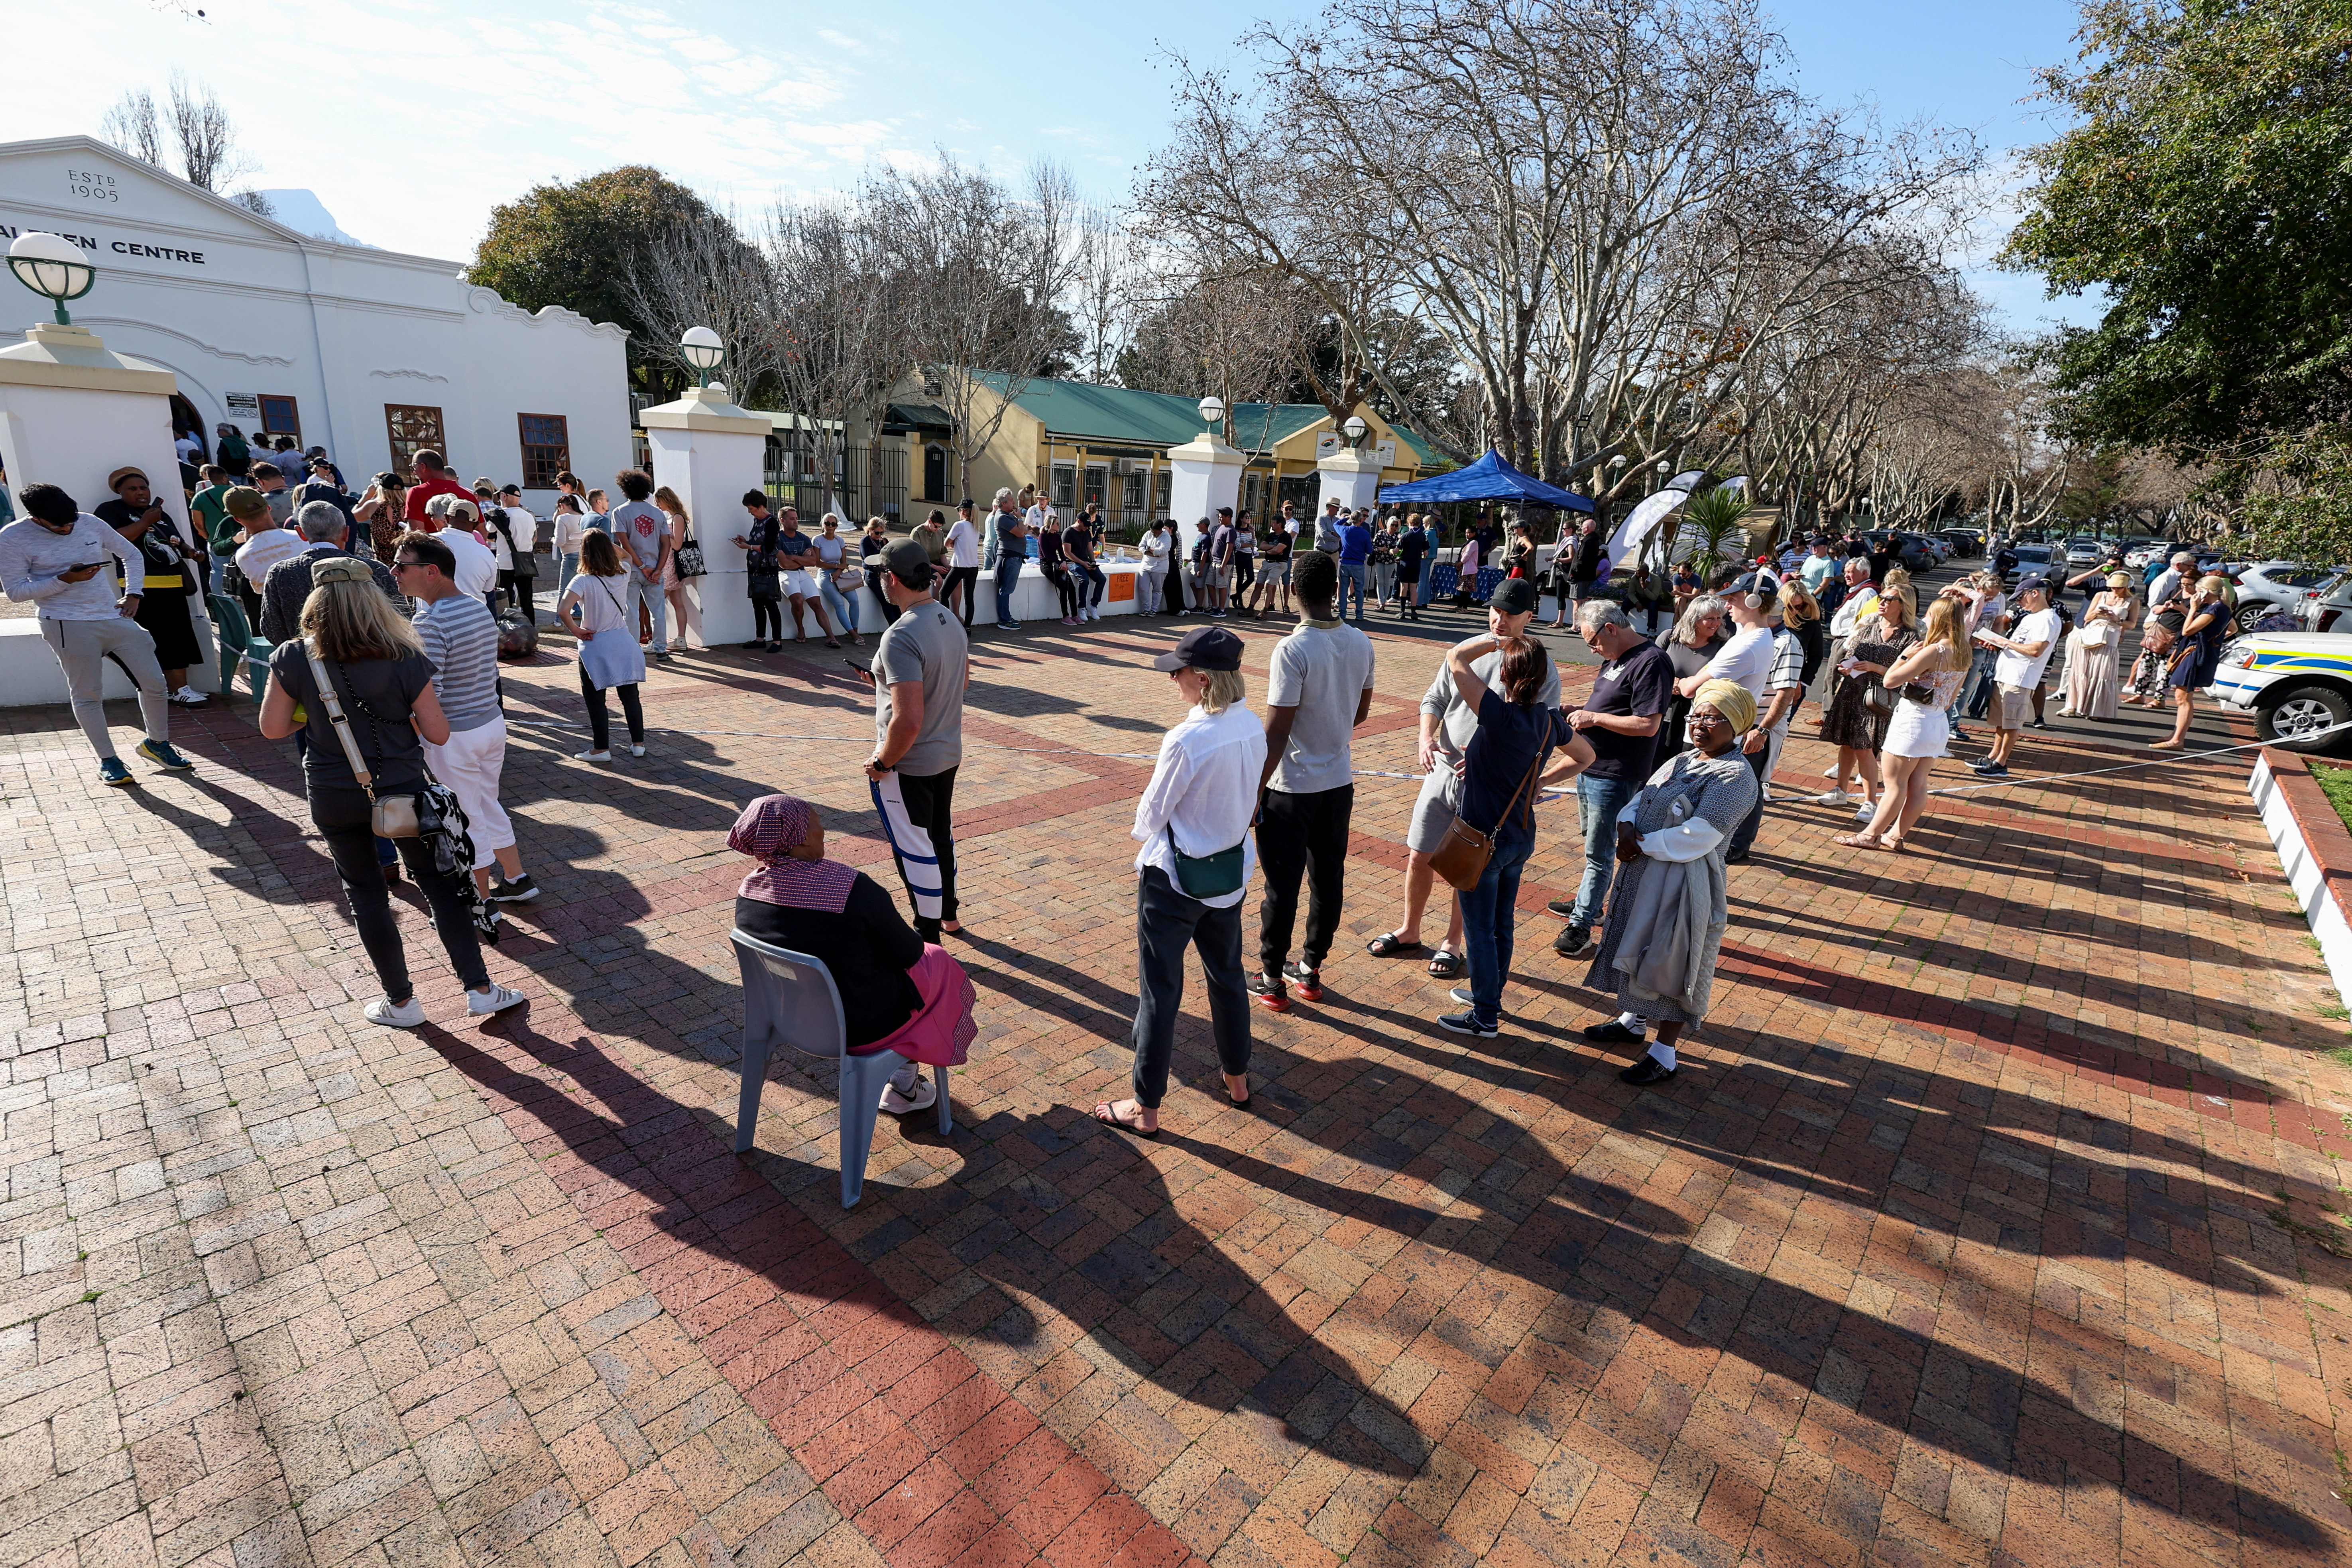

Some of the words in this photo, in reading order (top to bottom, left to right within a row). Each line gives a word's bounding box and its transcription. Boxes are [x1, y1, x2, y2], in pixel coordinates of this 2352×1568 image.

[68, 169, 115, 187] ESTD
[71, 184, 118, 202] 1905
[0, 224, 97, 250] ALEN
[111, 242, 205, 264] CENTRE
